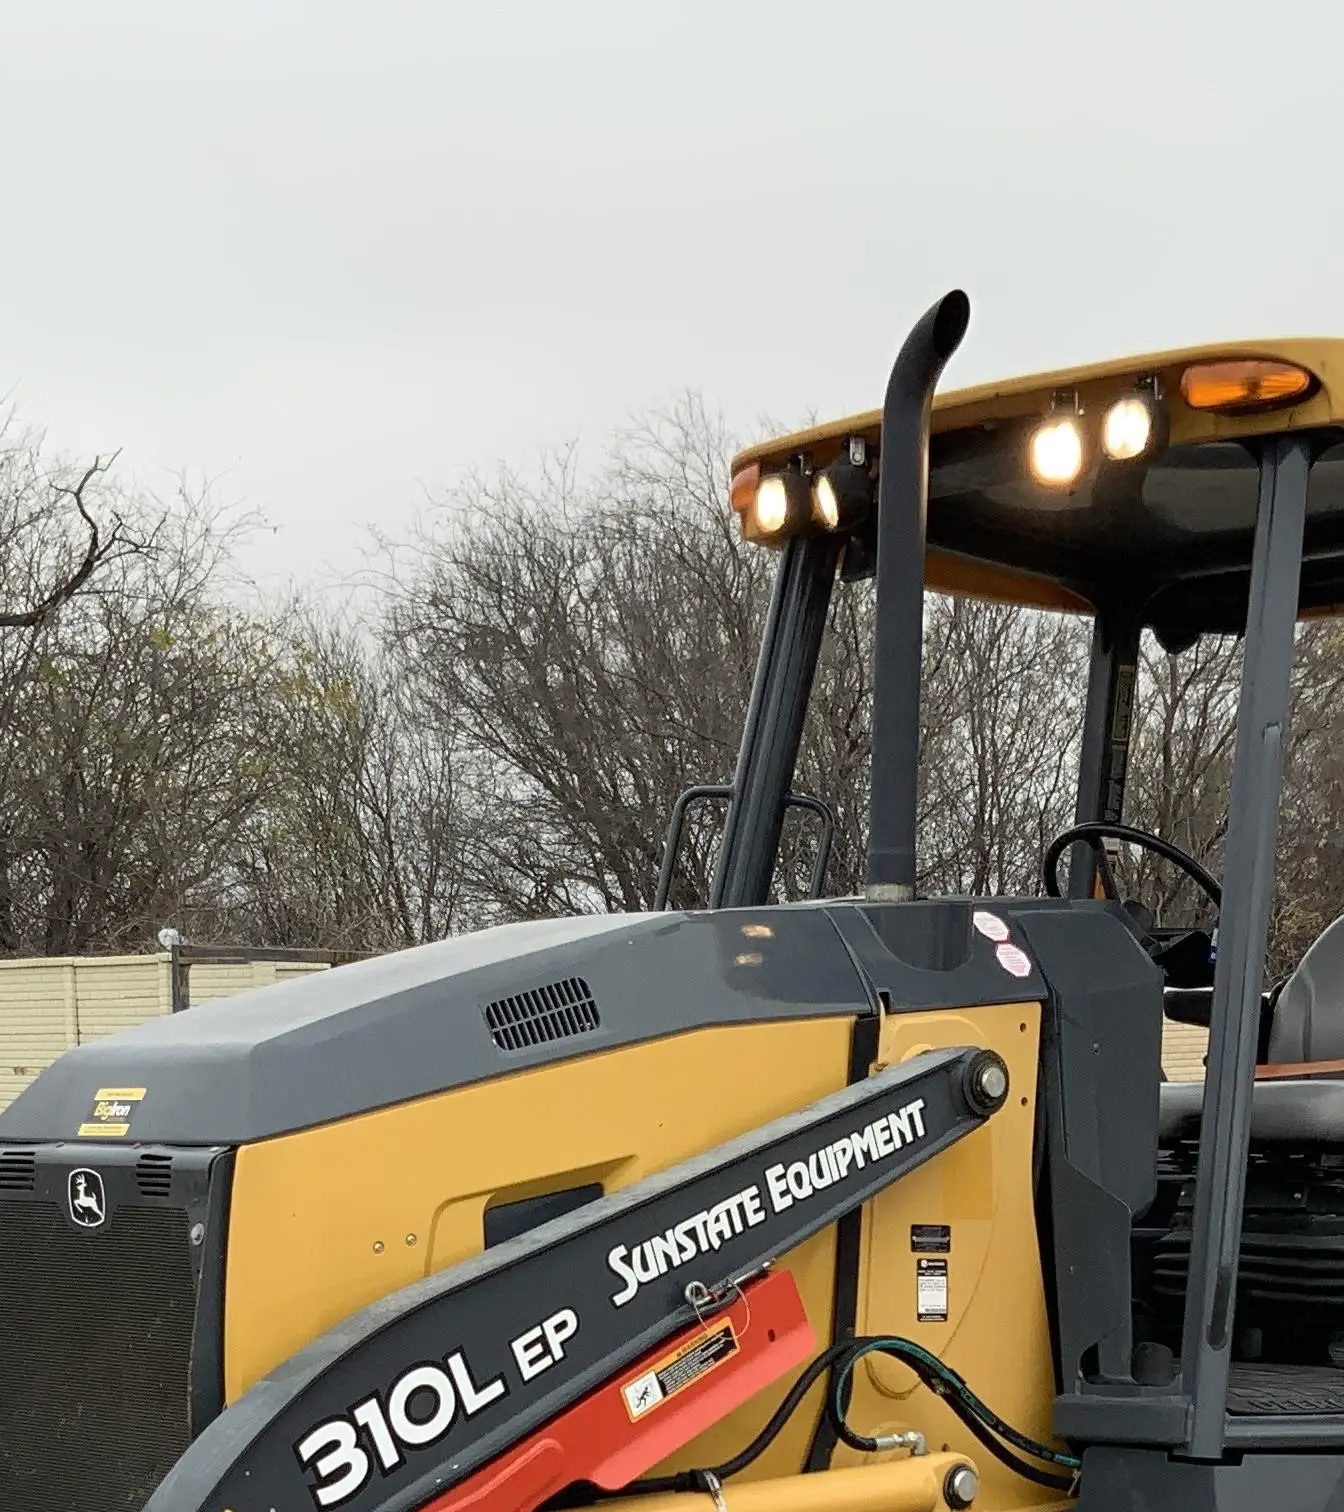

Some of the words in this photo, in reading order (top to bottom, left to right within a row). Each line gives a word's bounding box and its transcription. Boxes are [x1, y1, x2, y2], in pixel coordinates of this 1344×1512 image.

[608, 1185, 766, 1307] SUNSTATE
[765, 1099, 925, 1213] EQUIPMENT
[299, 1352, 506, 1506] 310L
[511, 1308, 578, 1382] EP
